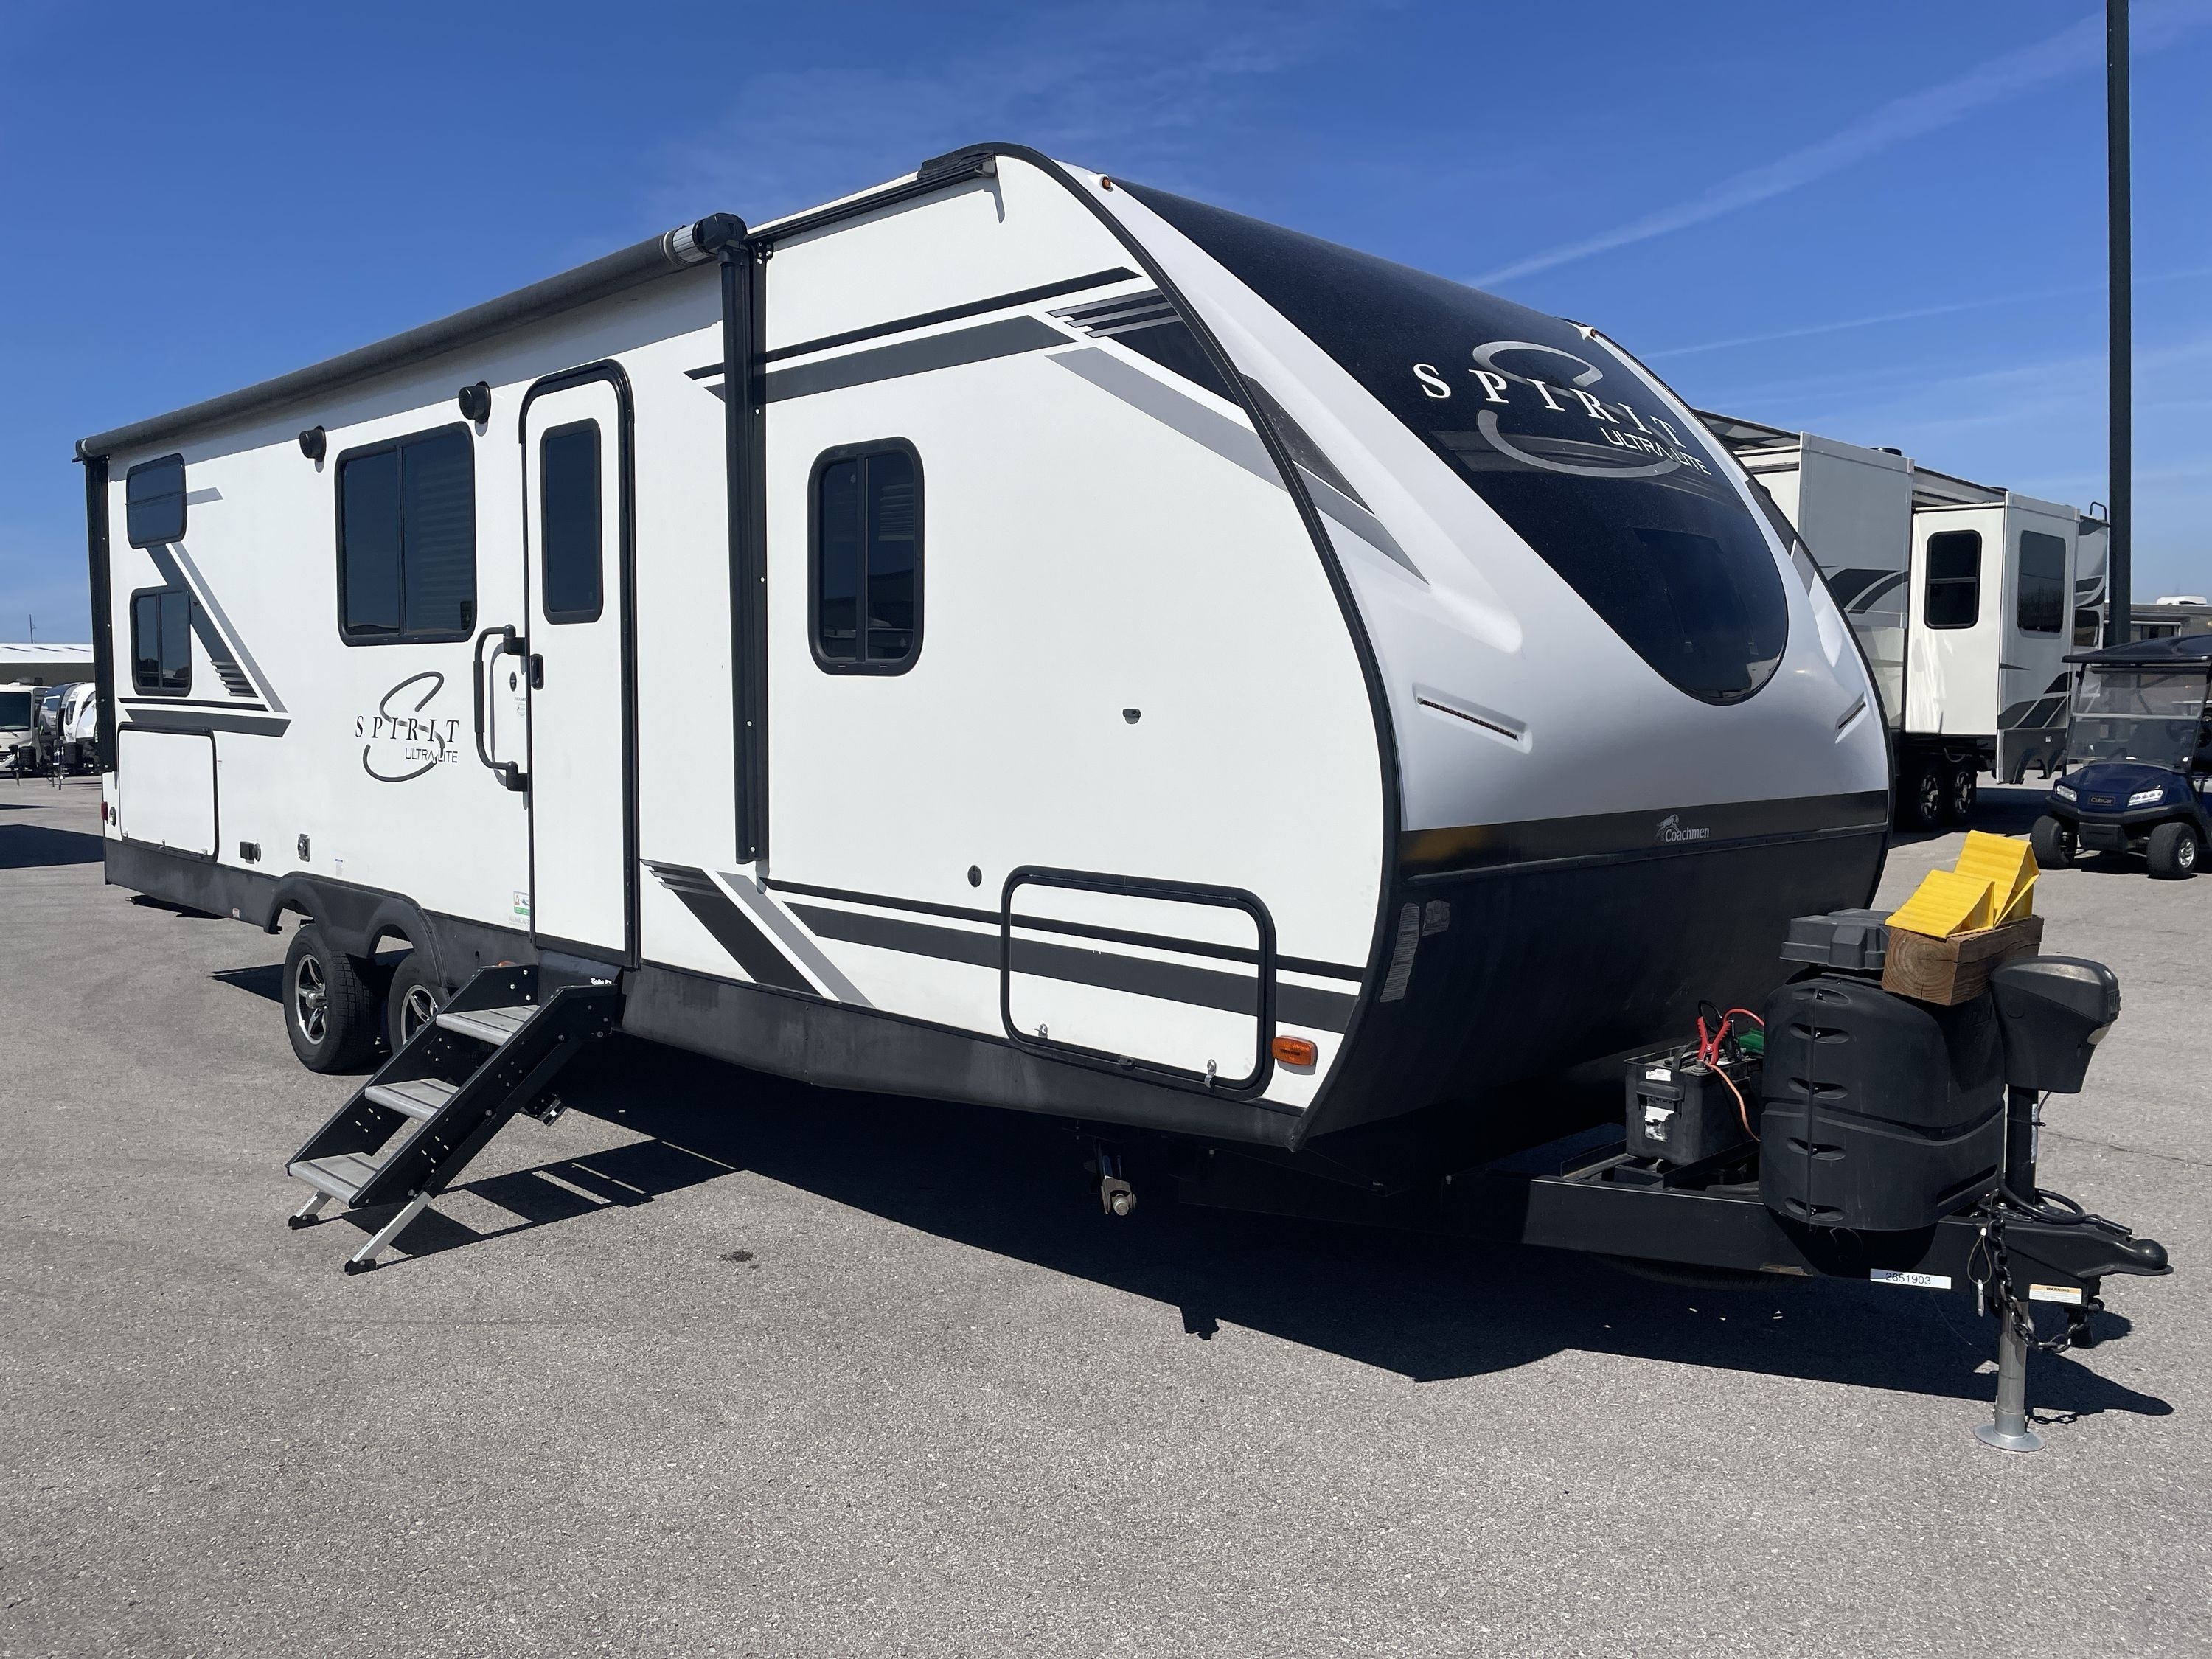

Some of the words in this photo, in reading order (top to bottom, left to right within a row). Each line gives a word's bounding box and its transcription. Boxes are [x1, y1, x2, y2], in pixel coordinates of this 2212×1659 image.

[1413, 363, 1687, 448] SPIRIT
[1599, 427, 1674, 460] ULTRA
[1670, 447, 1712, 476] LITE
[355, 715, 459, 743] SPIRIT
[406, 748, 436, 761] ULTRA
[438, 751, 459, 763] LITE
[1665, 826, 1710, 843] Coachmen
[1885, 1272, 1931, 1285] 2651903
